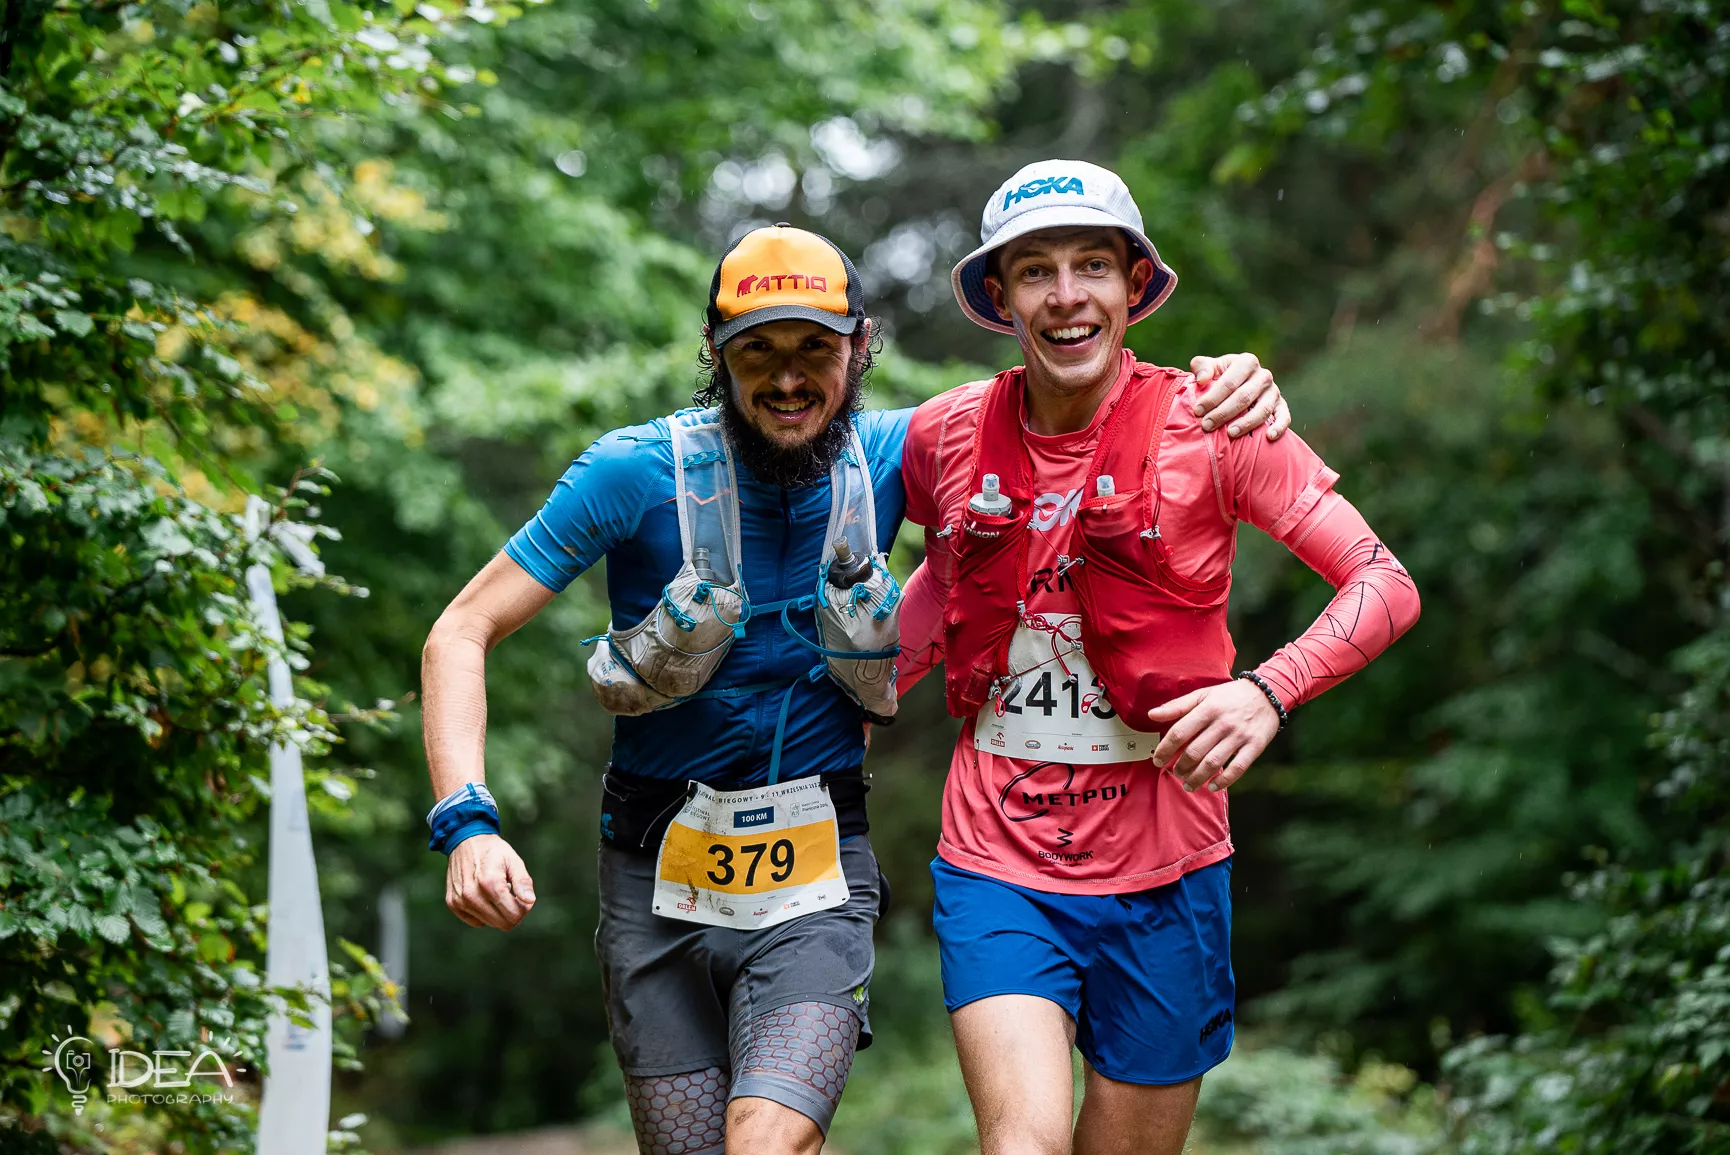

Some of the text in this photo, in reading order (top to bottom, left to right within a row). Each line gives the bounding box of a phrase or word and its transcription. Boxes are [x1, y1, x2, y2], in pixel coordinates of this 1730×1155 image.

[1003, 177, 1084, 211] HOKA
[756, 275, 827, 292] ATTIQ
[1033, 488, 1083, 531] OK
[718, 795, 753, 804] BIEGOWY
[741, 812, 768, 823] 100 KM
[707, 839, 795, 887] 379
[1038, 850, 1094, 862] BODYWORK
